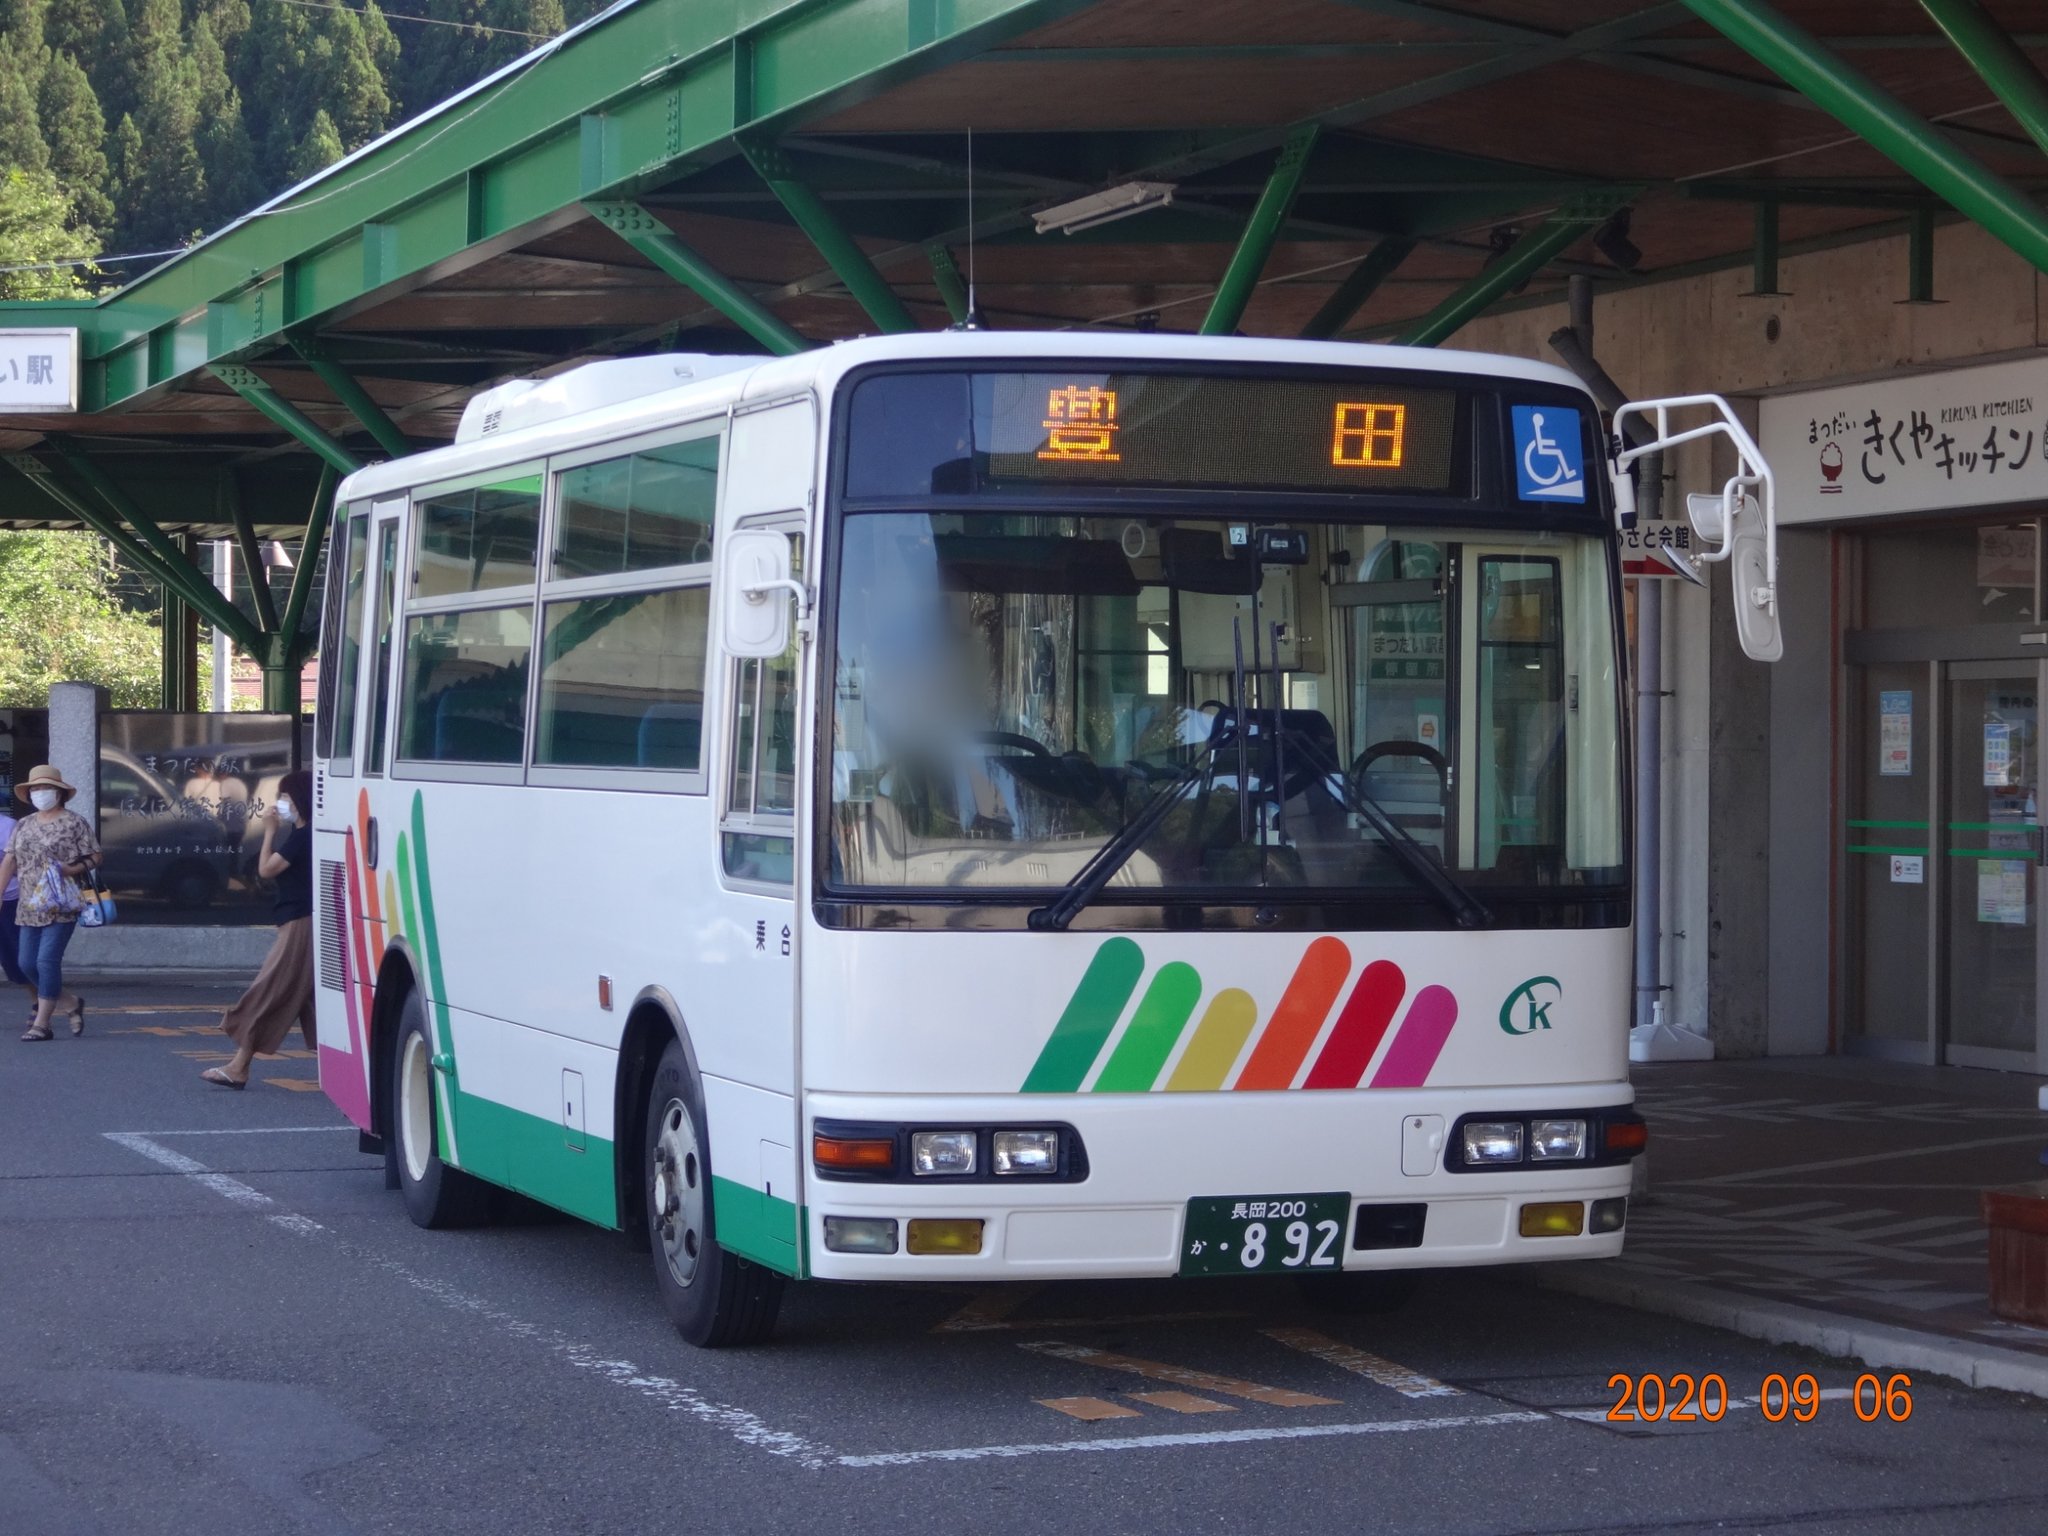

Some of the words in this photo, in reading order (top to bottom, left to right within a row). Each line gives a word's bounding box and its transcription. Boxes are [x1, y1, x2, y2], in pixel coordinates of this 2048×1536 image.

[1940, 405, 1978, 424] KIKUYA
[1808, 411, 1857, 445] まつだい
